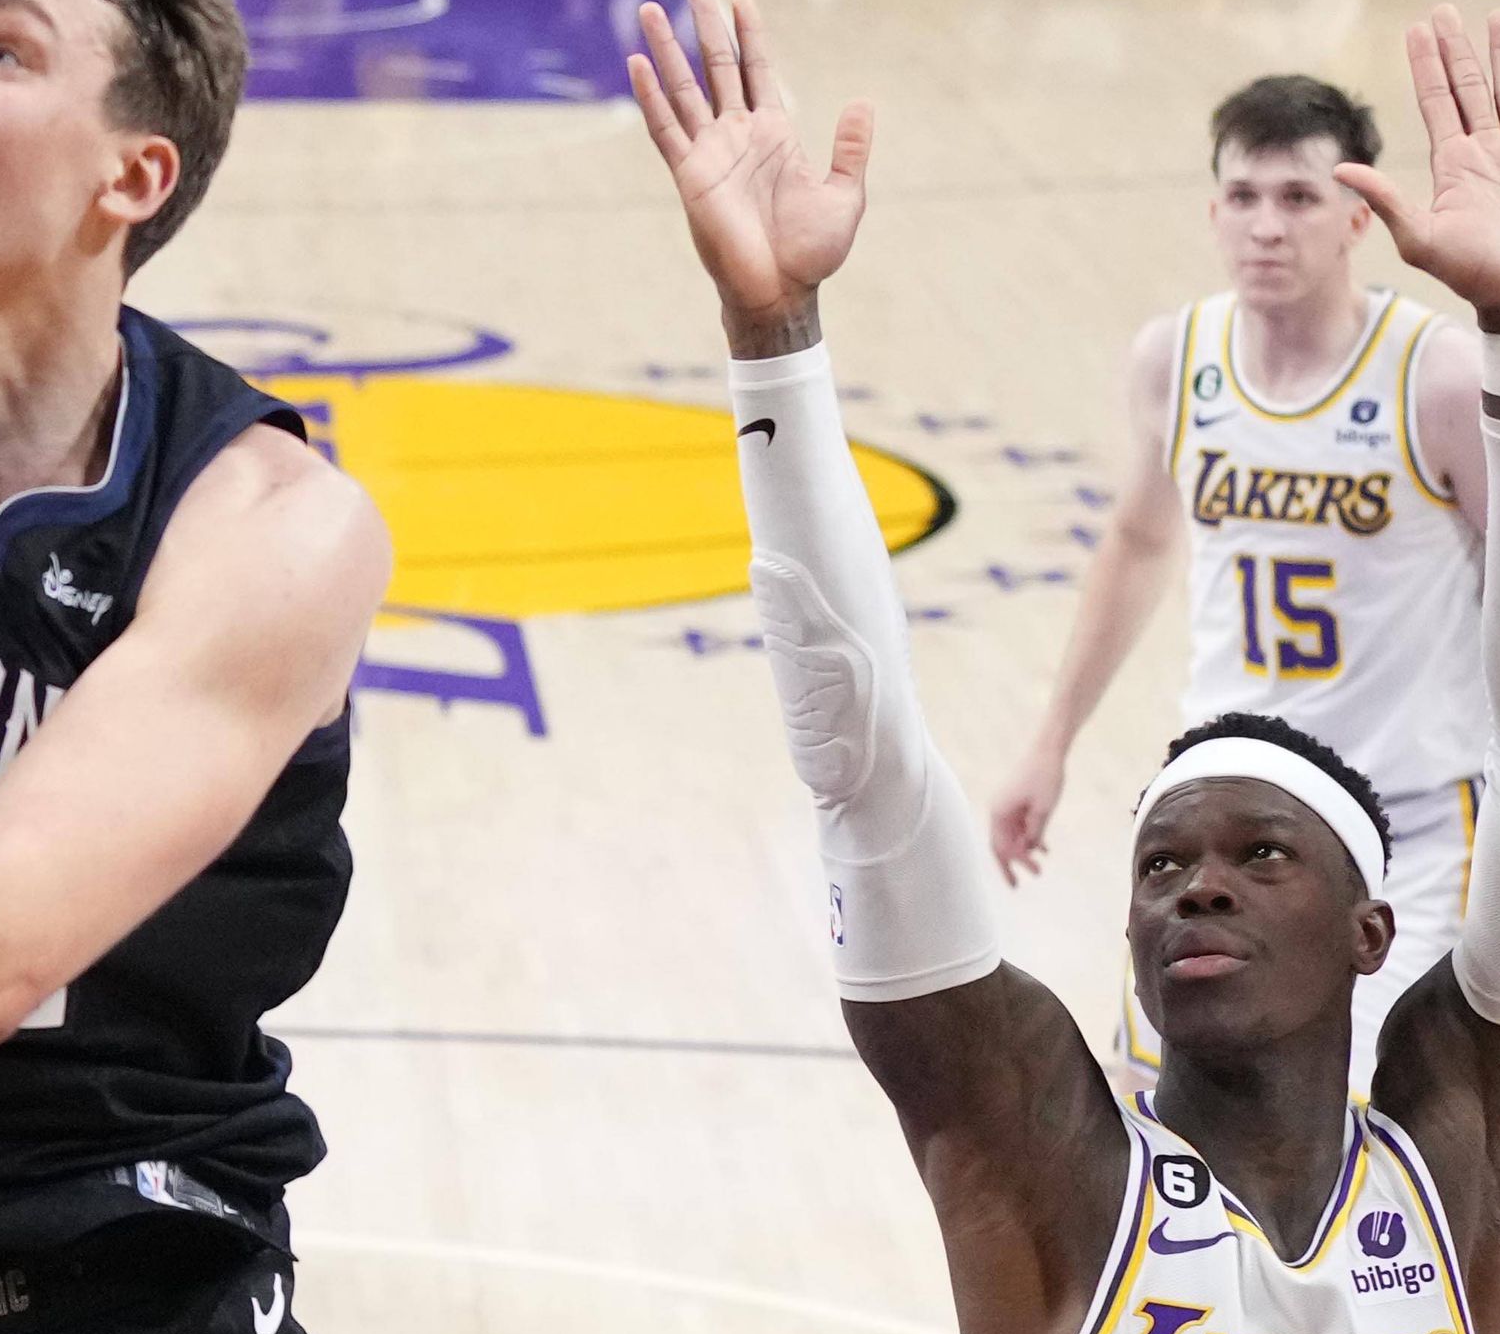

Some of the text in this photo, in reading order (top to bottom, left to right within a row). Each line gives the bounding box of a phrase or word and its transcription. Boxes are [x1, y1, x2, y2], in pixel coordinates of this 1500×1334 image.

[1190, 448, 1394, 537] LAKERS
[1234, 553, 1343, 680] 15
[1161, 1163, 1197, 1201] 6
[1351, 1261, 1436, 1295] bibigo
